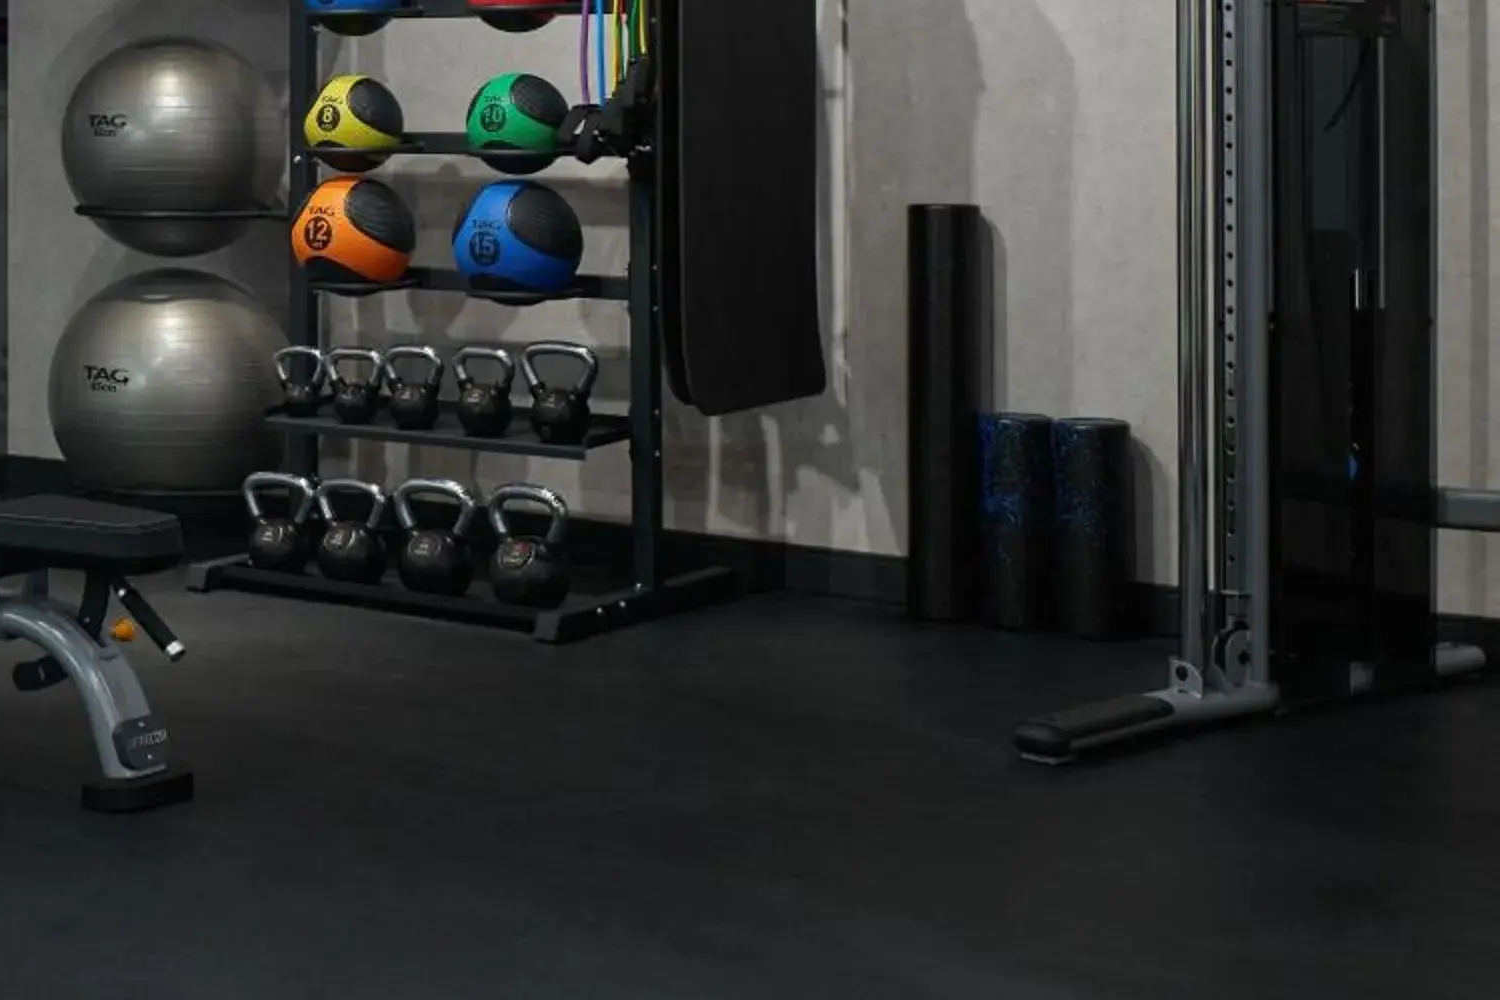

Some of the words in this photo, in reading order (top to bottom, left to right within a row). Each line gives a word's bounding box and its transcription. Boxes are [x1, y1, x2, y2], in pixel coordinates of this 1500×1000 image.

[307, 220, 328, 242] 12
[473, 235, 496, 256] 15
[82, 364, 130, 387] TAG
